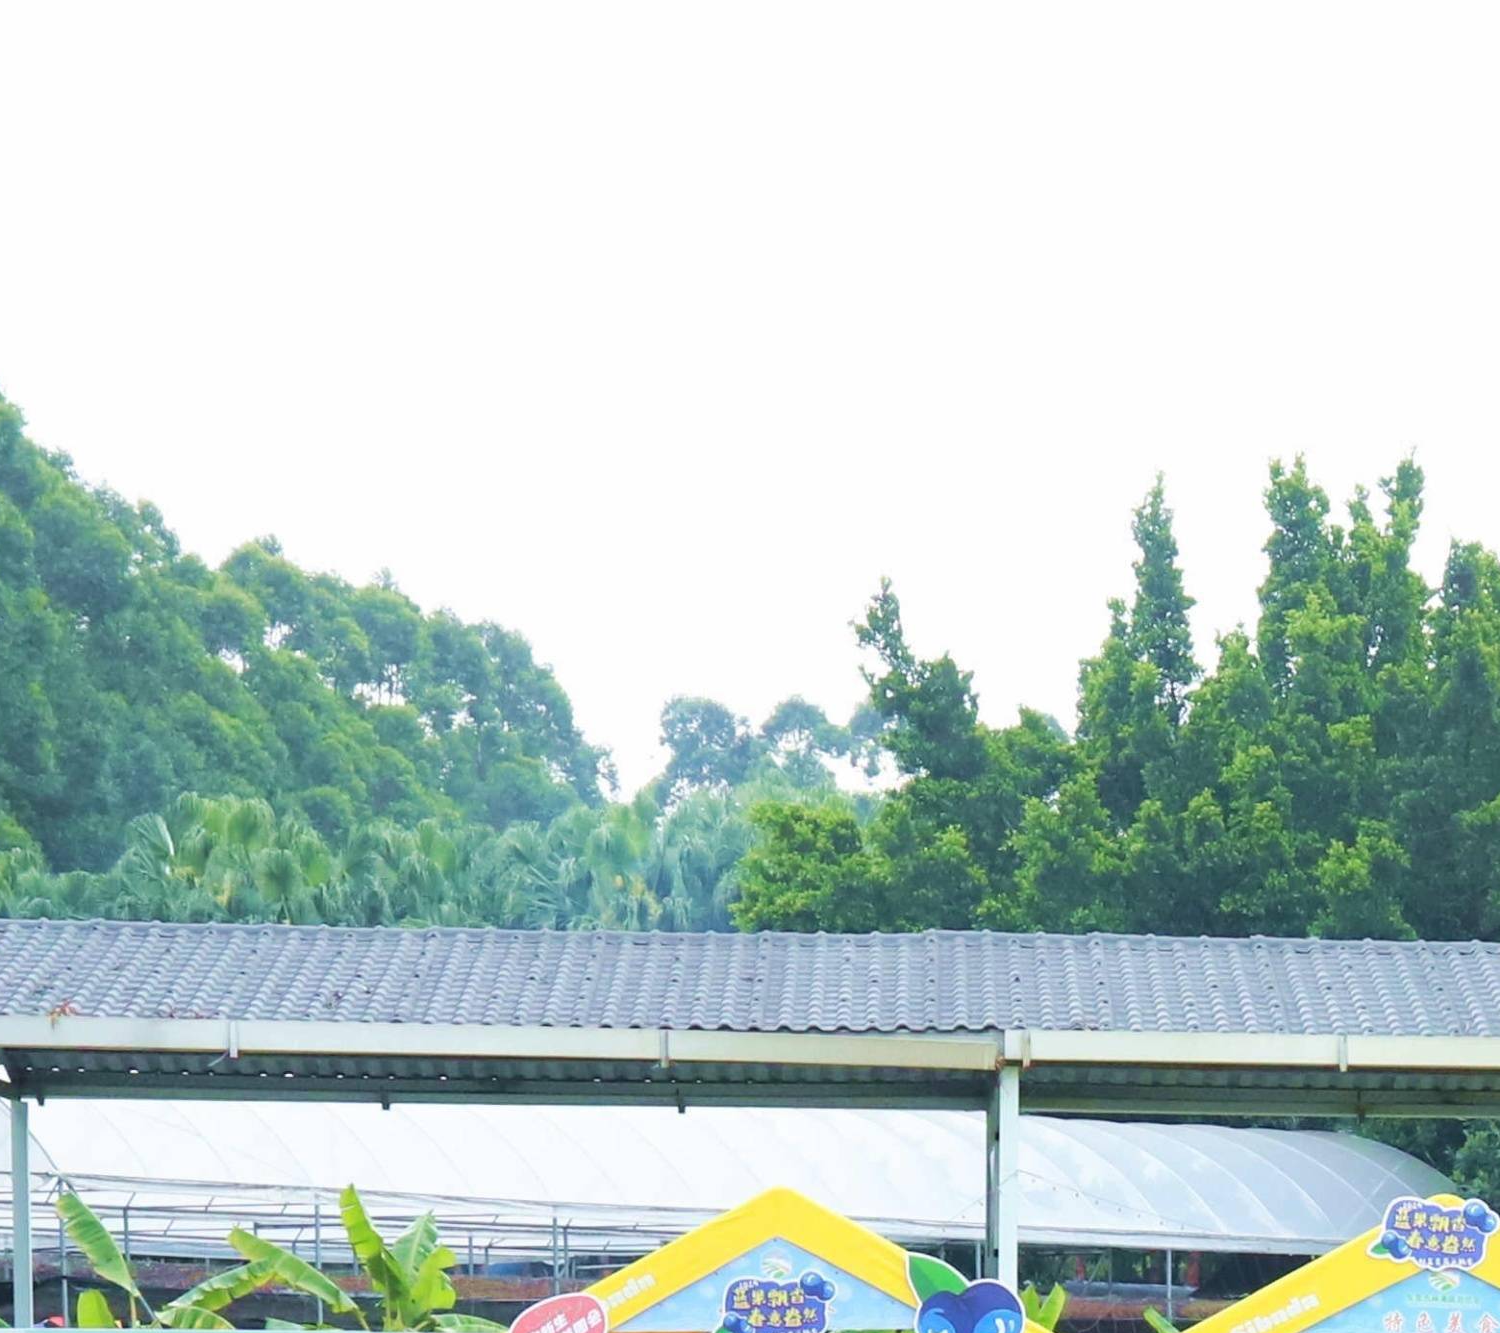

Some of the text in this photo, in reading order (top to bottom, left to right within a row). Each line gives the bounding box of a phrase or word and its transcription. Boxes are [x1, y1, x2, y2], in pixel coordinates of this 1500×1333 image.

[1394, 1208, 1465, 1232] 蓝果飘香
[1407, 1229, 1476, 1254] 春意盎然
[734, 1287, 804, 1309] 蓝果飘香
[748, 1308, 817, 1327] 春意盎然
